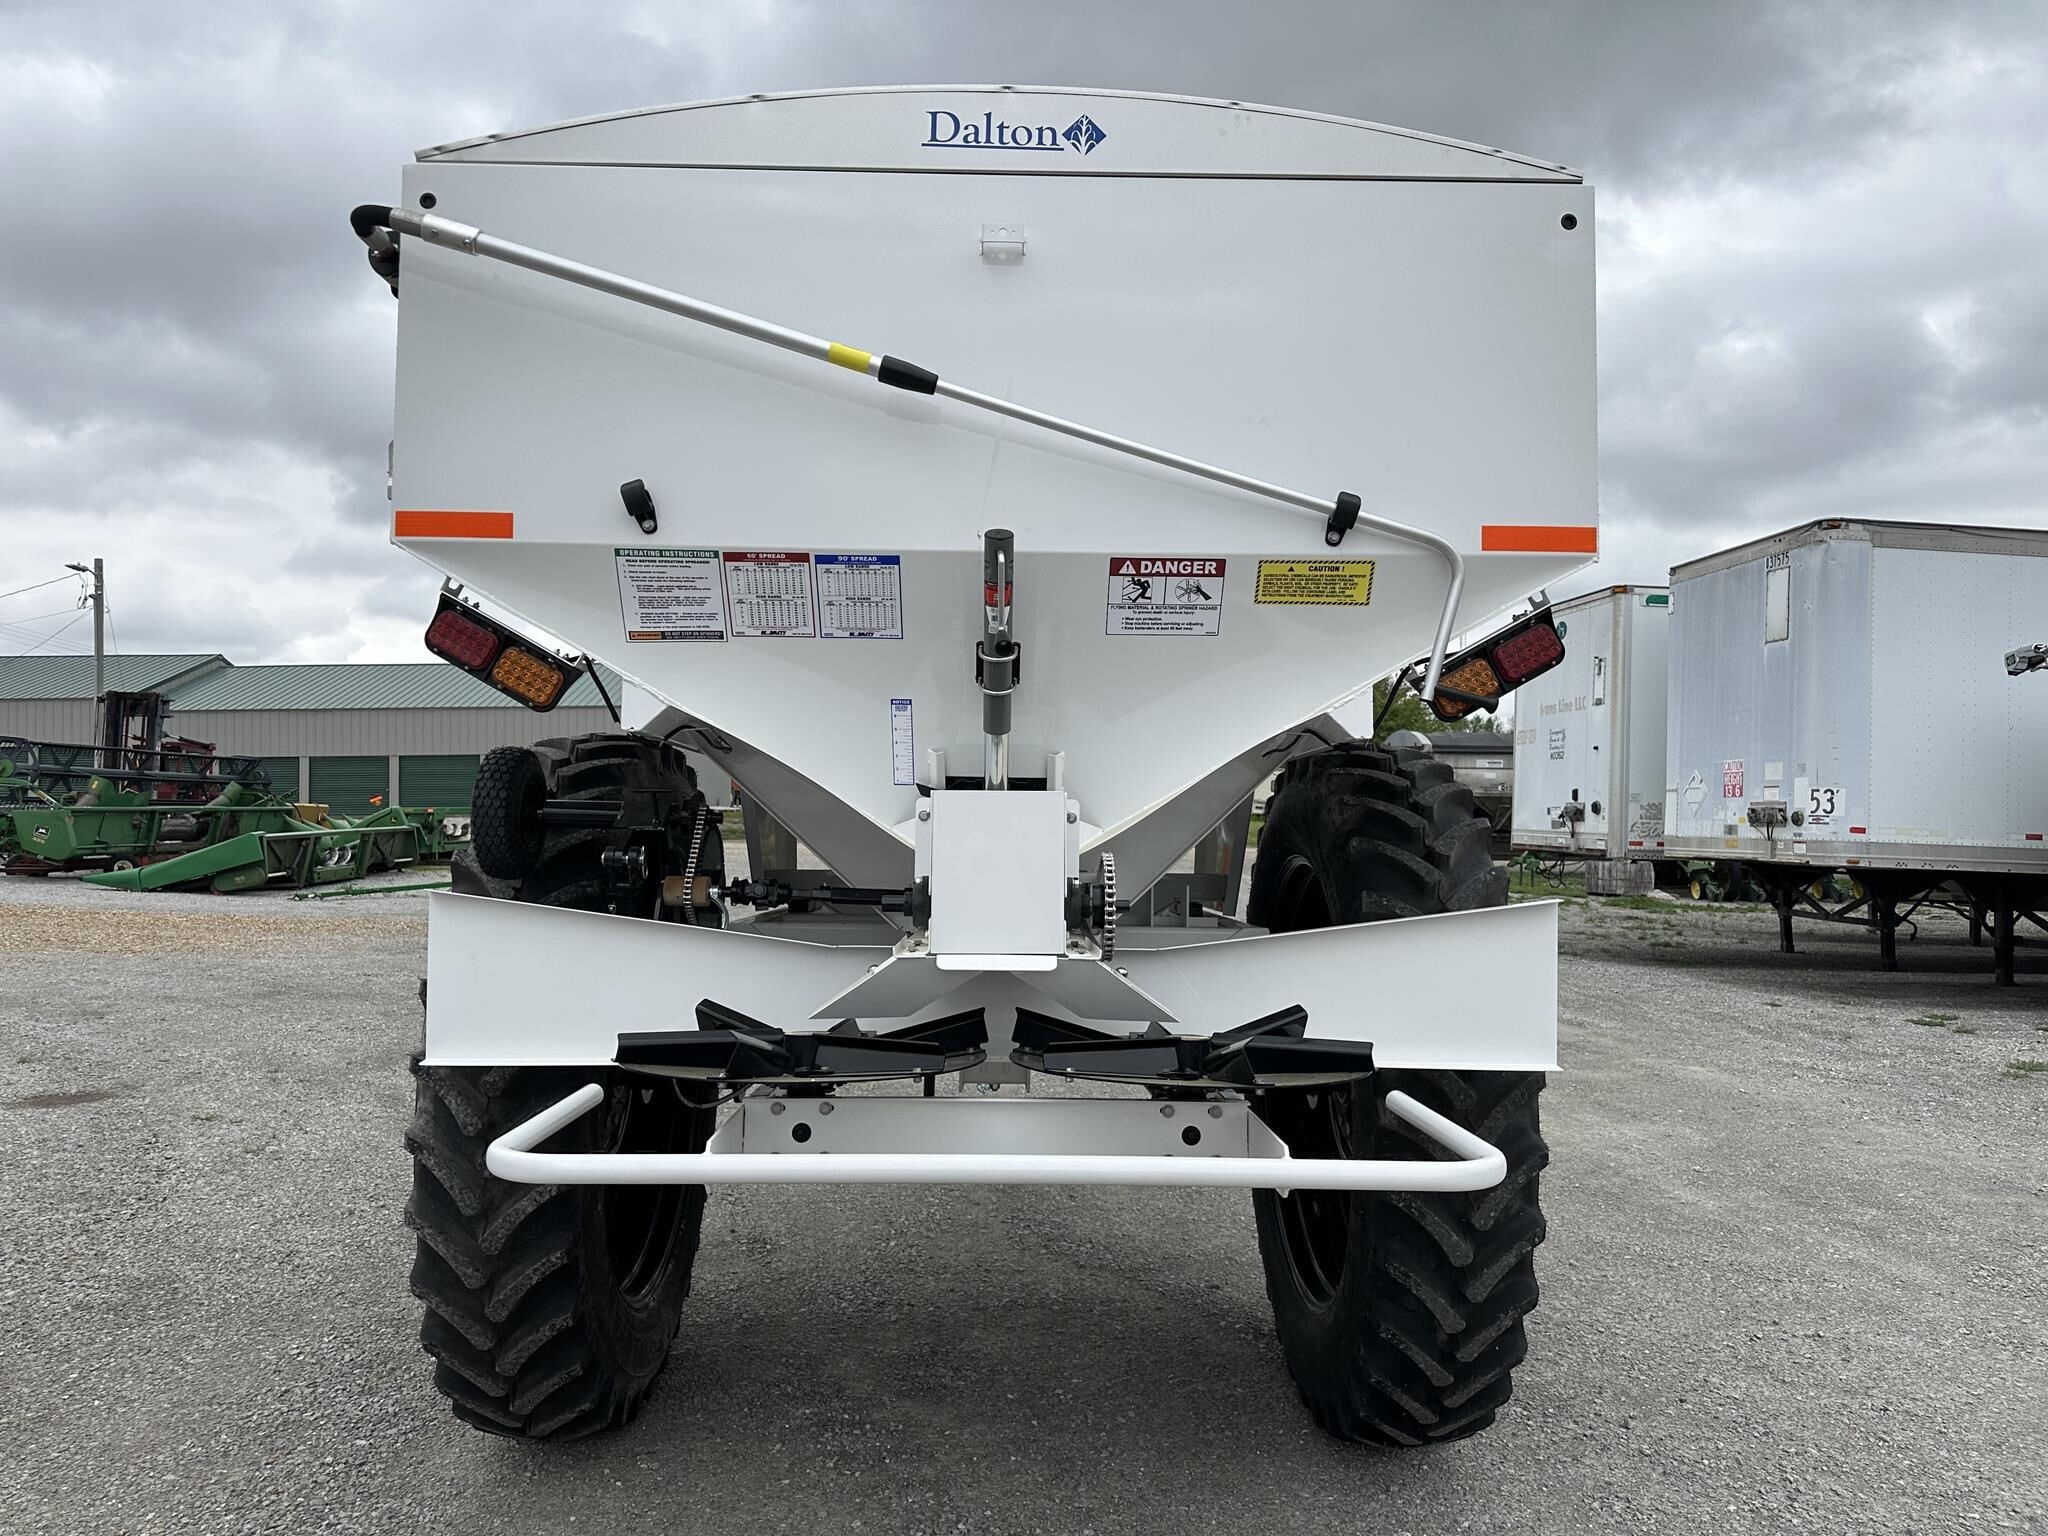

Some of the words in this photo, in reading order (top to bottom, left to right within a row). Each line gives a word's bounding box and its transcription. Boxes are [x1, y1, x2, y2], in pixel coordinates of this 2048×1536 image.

[926, 111, 1060, 146] Dalton
[1140, 561, 1216, 574] DANGER
[1558, 698, 1572, 713] Line
[1574, 696, 1586, 710] LLC
[1724, 761, 1743, 772] CAUTION
[1724, 773, 1743, 785] HEIGHT
[1725, 786, 1732, 797] 13
[1735, 786, 1740, 797] 6
